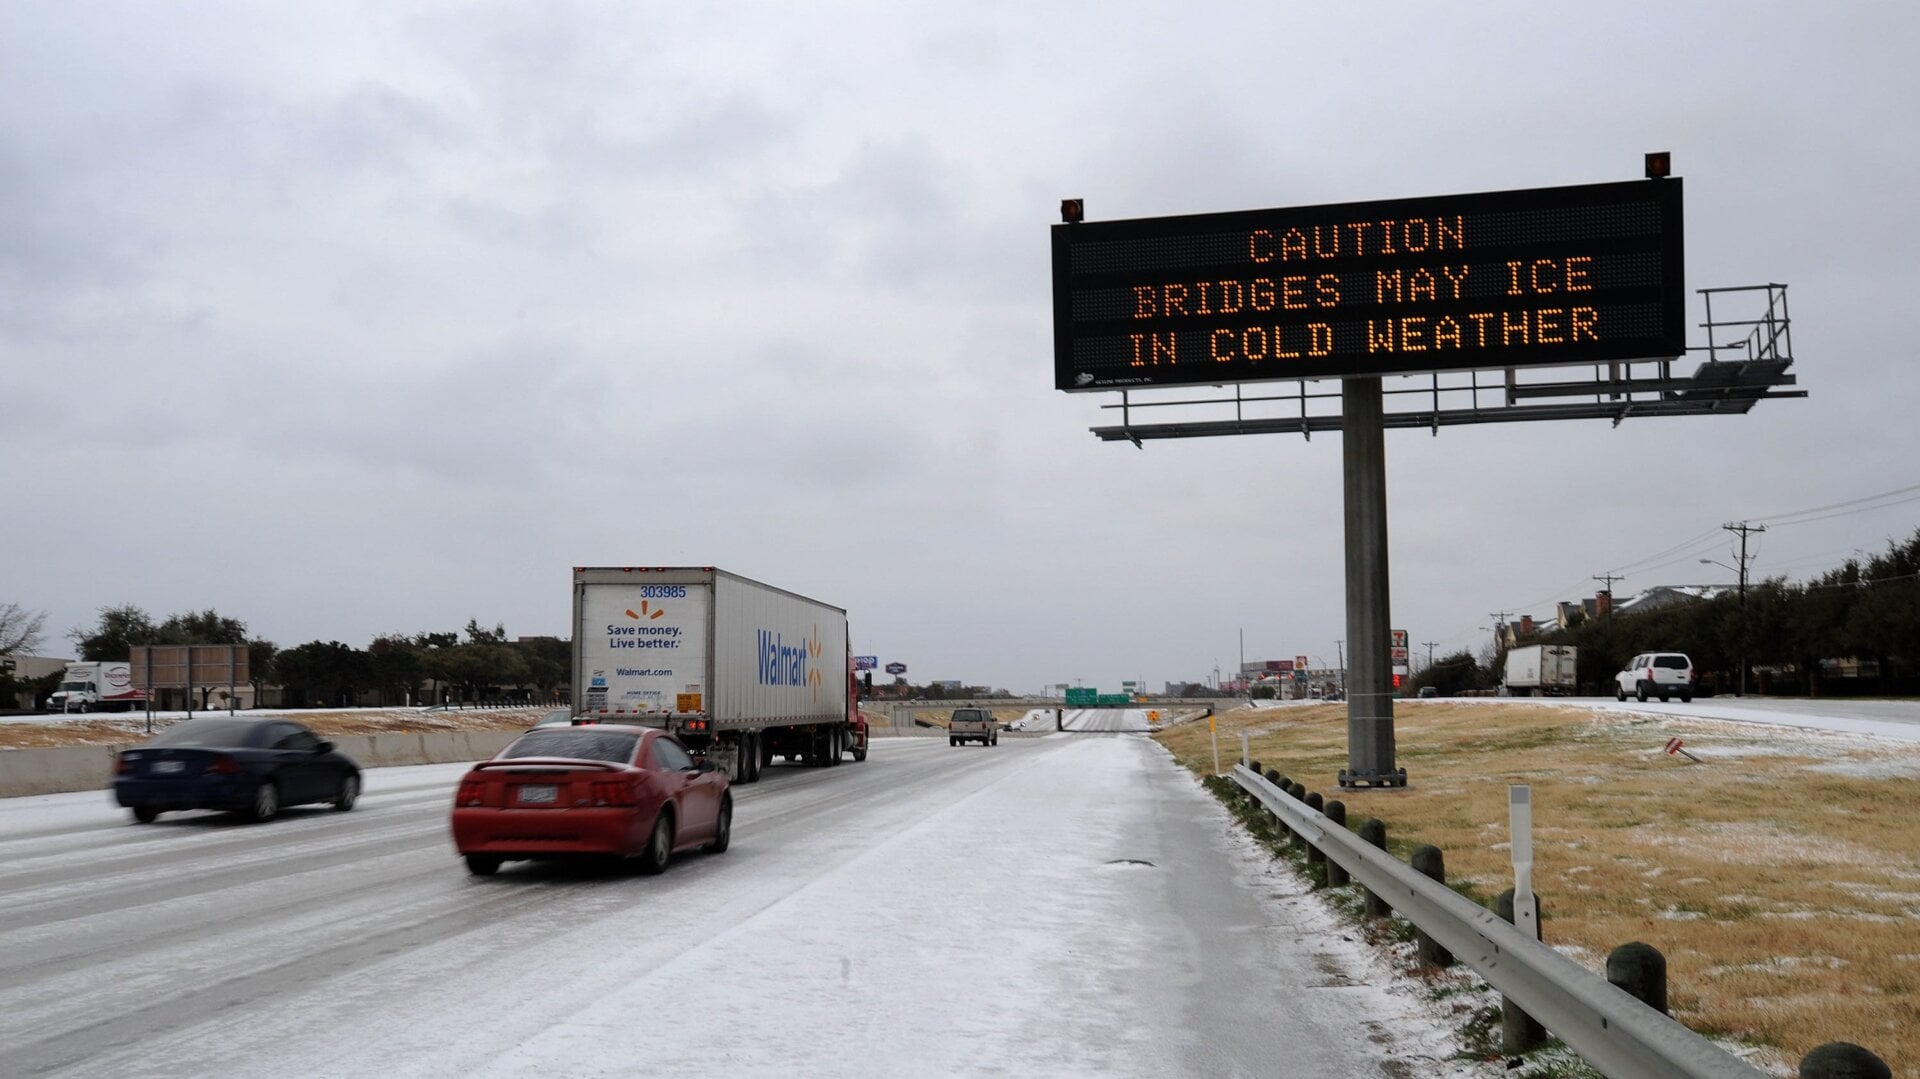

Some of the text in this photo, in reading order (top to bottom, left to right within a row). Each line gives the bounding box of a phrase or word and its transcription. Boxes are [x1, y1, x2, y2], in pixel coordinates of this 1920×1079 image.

[1250, 215, 1467, 264] CAUTION
[1133, 256, 1592, 319] BRIDGES MAY ICE
[1131, 306, 1599, 367] IN COLD WEATHER
[640, 586, 686, 598] 303985
[607, 625, 682, 639] Save money.
[610, 638, 679, 648] Live better.
[616, 668, 673, 676] Walmart.com
[757, 629, 807, 687] Walmart
